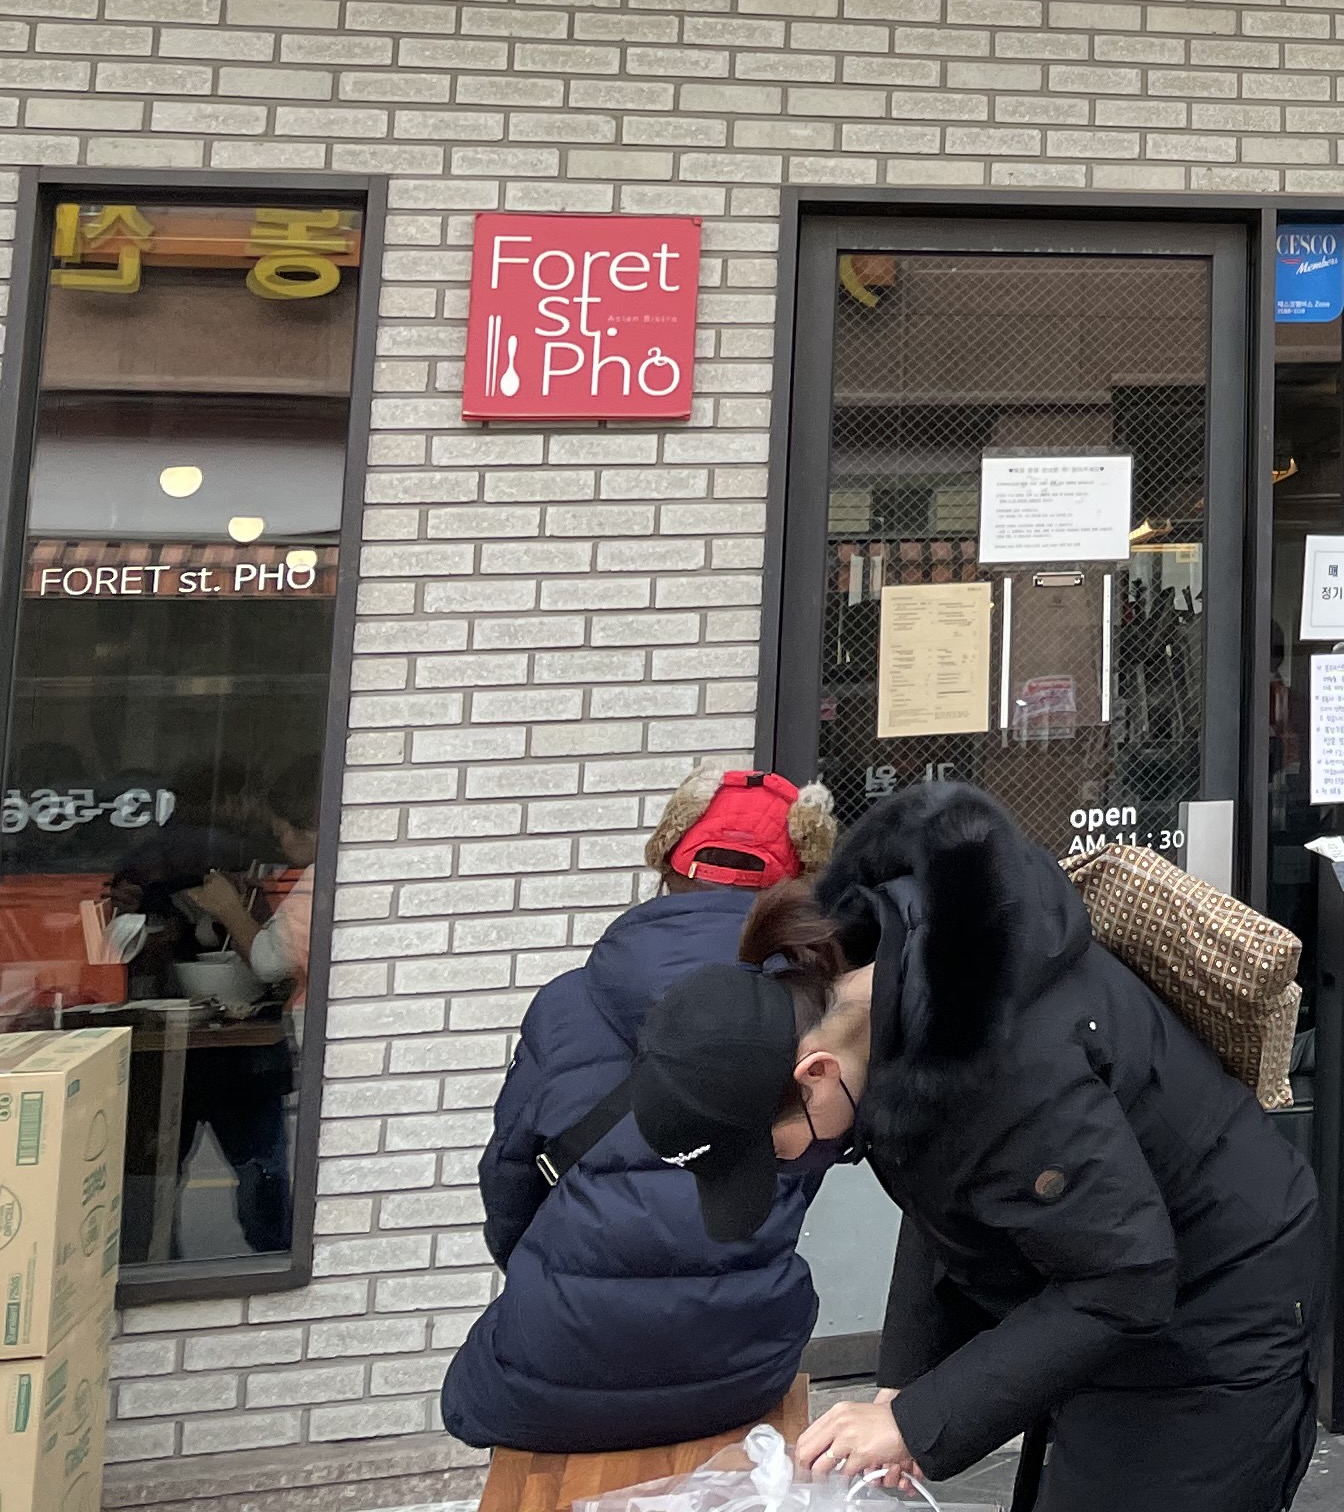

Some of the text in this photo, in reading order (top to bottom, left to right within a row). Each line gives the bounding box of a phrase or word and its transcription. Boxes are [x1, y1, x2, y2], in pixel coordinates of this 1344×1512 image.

[1275, 233, 1337, 256] CESCO
[490, 235, 681, 292] Foret
[1295, 254, 1339, 276] Members
[534, 295, 619, 338] st.
[40, 564, 171, 596] FORET
[178, 567, 222, 593] st.
[1321, 586, 1343, 600] 정기
[1069, 806, 1137, 832] open
[1068, 834, 1106, 855] AM
